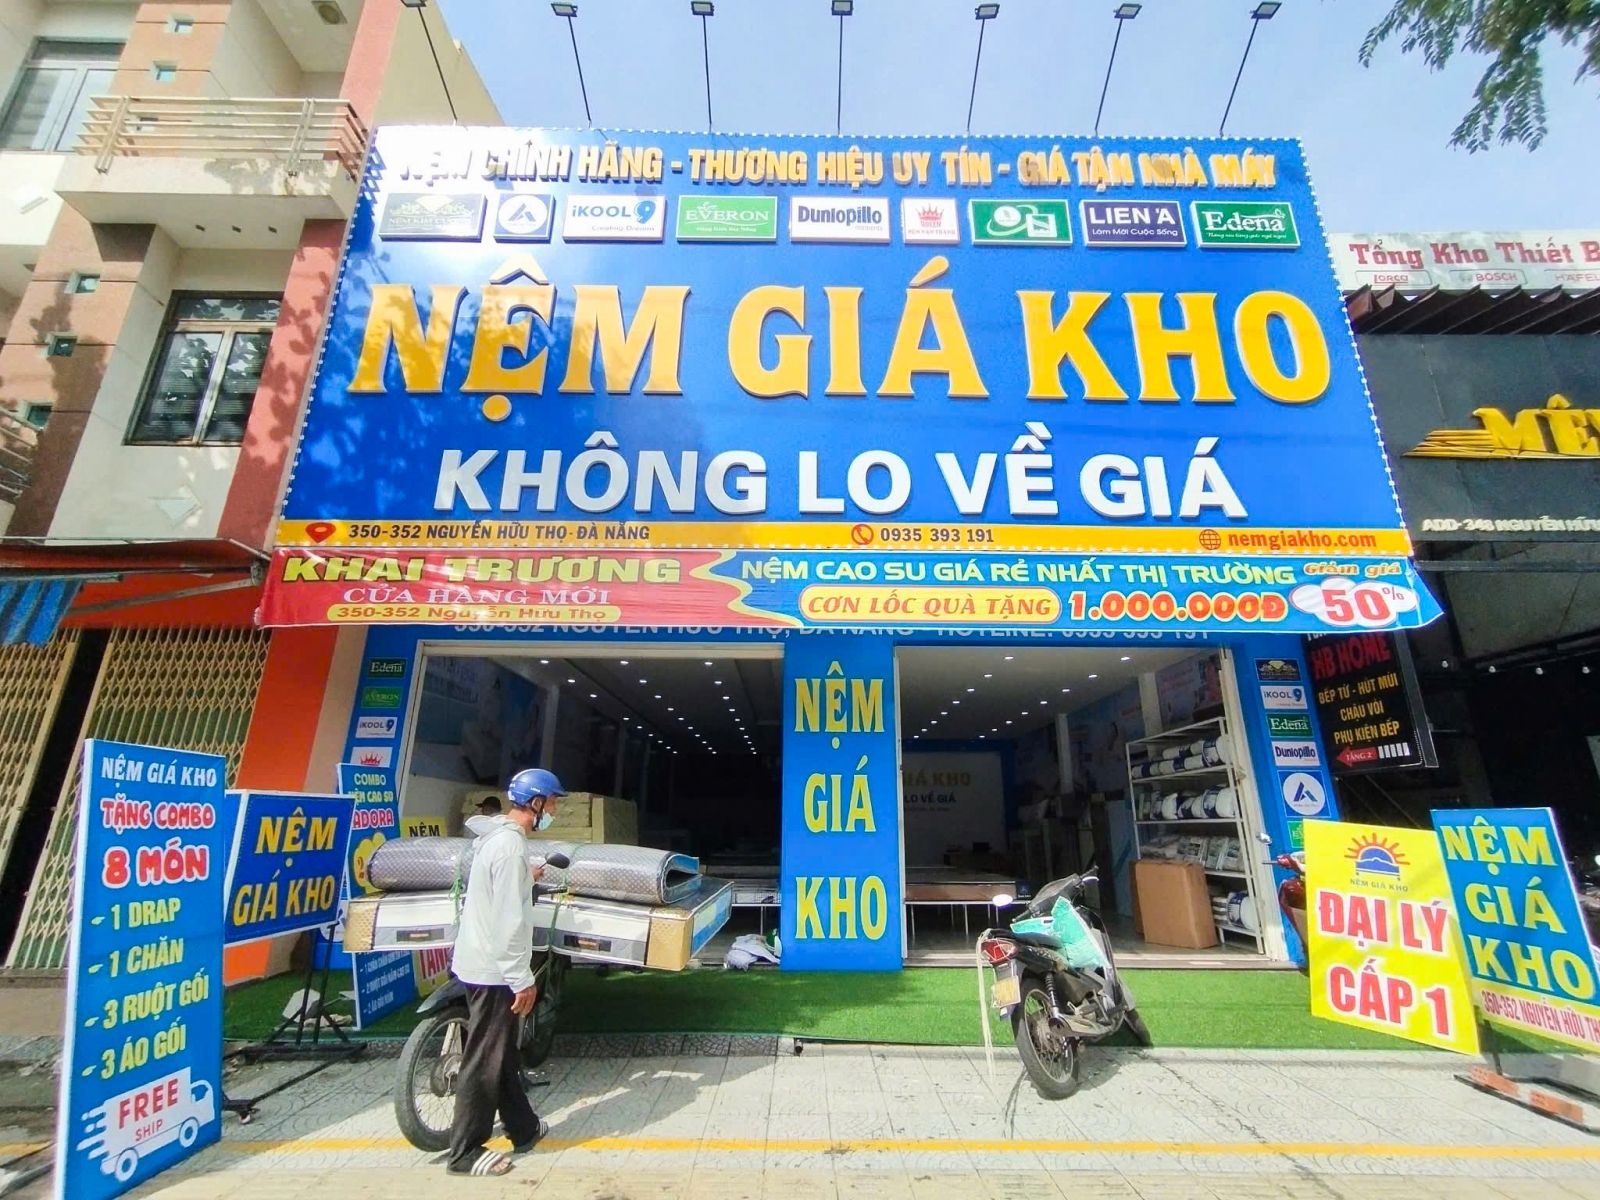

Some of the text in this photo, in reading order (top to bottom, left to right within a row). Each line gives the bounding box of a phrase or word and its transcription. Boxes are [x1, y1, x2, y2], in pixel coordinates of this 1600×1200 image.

[688, 147, 808, 185] THƯƠNG
[816, 145, 884, 191] HIỆU
[892, 150, 931, 186] UY
[941, 145, 993, 187] TÍN
[1016, 145, 1071, 186] GIÁ
[1072, 145, 1135, 193] TẬN
[1137, 146, 1208, 187] NHÀ
[1208, 147, 1277, 188] MÁY
[685, 209, 770, 221] EVERON
[797, 205, 882, 226] Dunlopillo
[1201, 211, 1285, 232] Edena
[1349, 239, 1424, 269] Tổng
[1430, 242, 1490, 263] Kho
[1494, 237, 1574, 263] Thiết
[1475, 273, 1519, 282] BOSCH
[346, 253, 1331, 422] NỆM GIÁ KHO
[433, 421, 1250, 518] KHÔNG LO VỀ GIÁ
[348, 524, 422, 539] 350-352
[426, 520, 492, 540] NGUYỄN
[497, 521, 530, 539] HỮU
[535, 525, 567, 543] THỌ
[576, 522, 599, 540] ĐÀ
[880, 528, 994, 543] 0935 393 191
[1228, 529, 1377, 551] nemgiakho.com
[282, 552, 681, 583] KHAI TRƯƠNG
[741, 557, 1297, 587] NỆM CAO SU GIÁ RẺ NHẤT THỊ TRƯỜNG
[1303, 561, 1402, 578] Giảm giá
[343, 582, 611, 605] CỬA HÀNG MỚI
[807, 588, 1052, 620] CƠN LỐC QUÀ TẶNG
[1068, 590, 1289, 623] 1.000.000Đ
[1322, 586, 1404, 622] 50%
[336, 606, 420, 619] 350-352
[568, 608, 607, 622] Thọ
[370, 662, 403, 673] Edena
[1311, 631, 1392, 680] HB HOME
[1357, 677, 1376, 695] HÚT
[793, 661, 885, 750] NỆM
[1340, 703, 1366, 722] CHẬU
[1270, 718, 1309, 731] Edena
[1333, 716, 1400, 746] PHỤ KIỆN BẾP
[1275, 746, 1316, 759] Dunlopillo
[101, 754, 217, 788] NỆM GIÁ KHO
[354, 773, 387, 786] COMBO
[933, 772, 972, 788] KHO
[348, 787, 366, 806] ỆM
[803, 754, 877, 834] GIÁ
[936, 791, 957, 803] GIÁ
[101, 794, 216, 835] TẶNG COMBO
[352, 808, 394, 830] ADORA
[254, 806, 338, 868] NỆM
[1438, 815, 1559, 876] NỆM
[102, 837, 210, 889] 8 MÓN
[232, 869, 336, 927] GIÁ KHO
[1388, 883, 1409, 892] KHO
[111, 897, 181, 930] 1 DRAP
[794, 875, 888, 940] KHO
[1464, 876, 1568, 934] GIÁ
[1317, 890, 1448, 953] ĐẠI LÝ
[109, 936, 184, 977] 1 CHĂN
[1467, 934, 1595, 1000] KHO
[102, 967, 210, 1030] 3 RUỘT GỐI
[1329, 959, 1449, 1036] CẤP 1
[1481, 990, 1521, 1021] 350-352
[101, 1017, 187, 1080] 3 ÁO GỐI
[118, 1078, 179, 1130] FREE
[135, 1118, 164, 1142] SHIP
